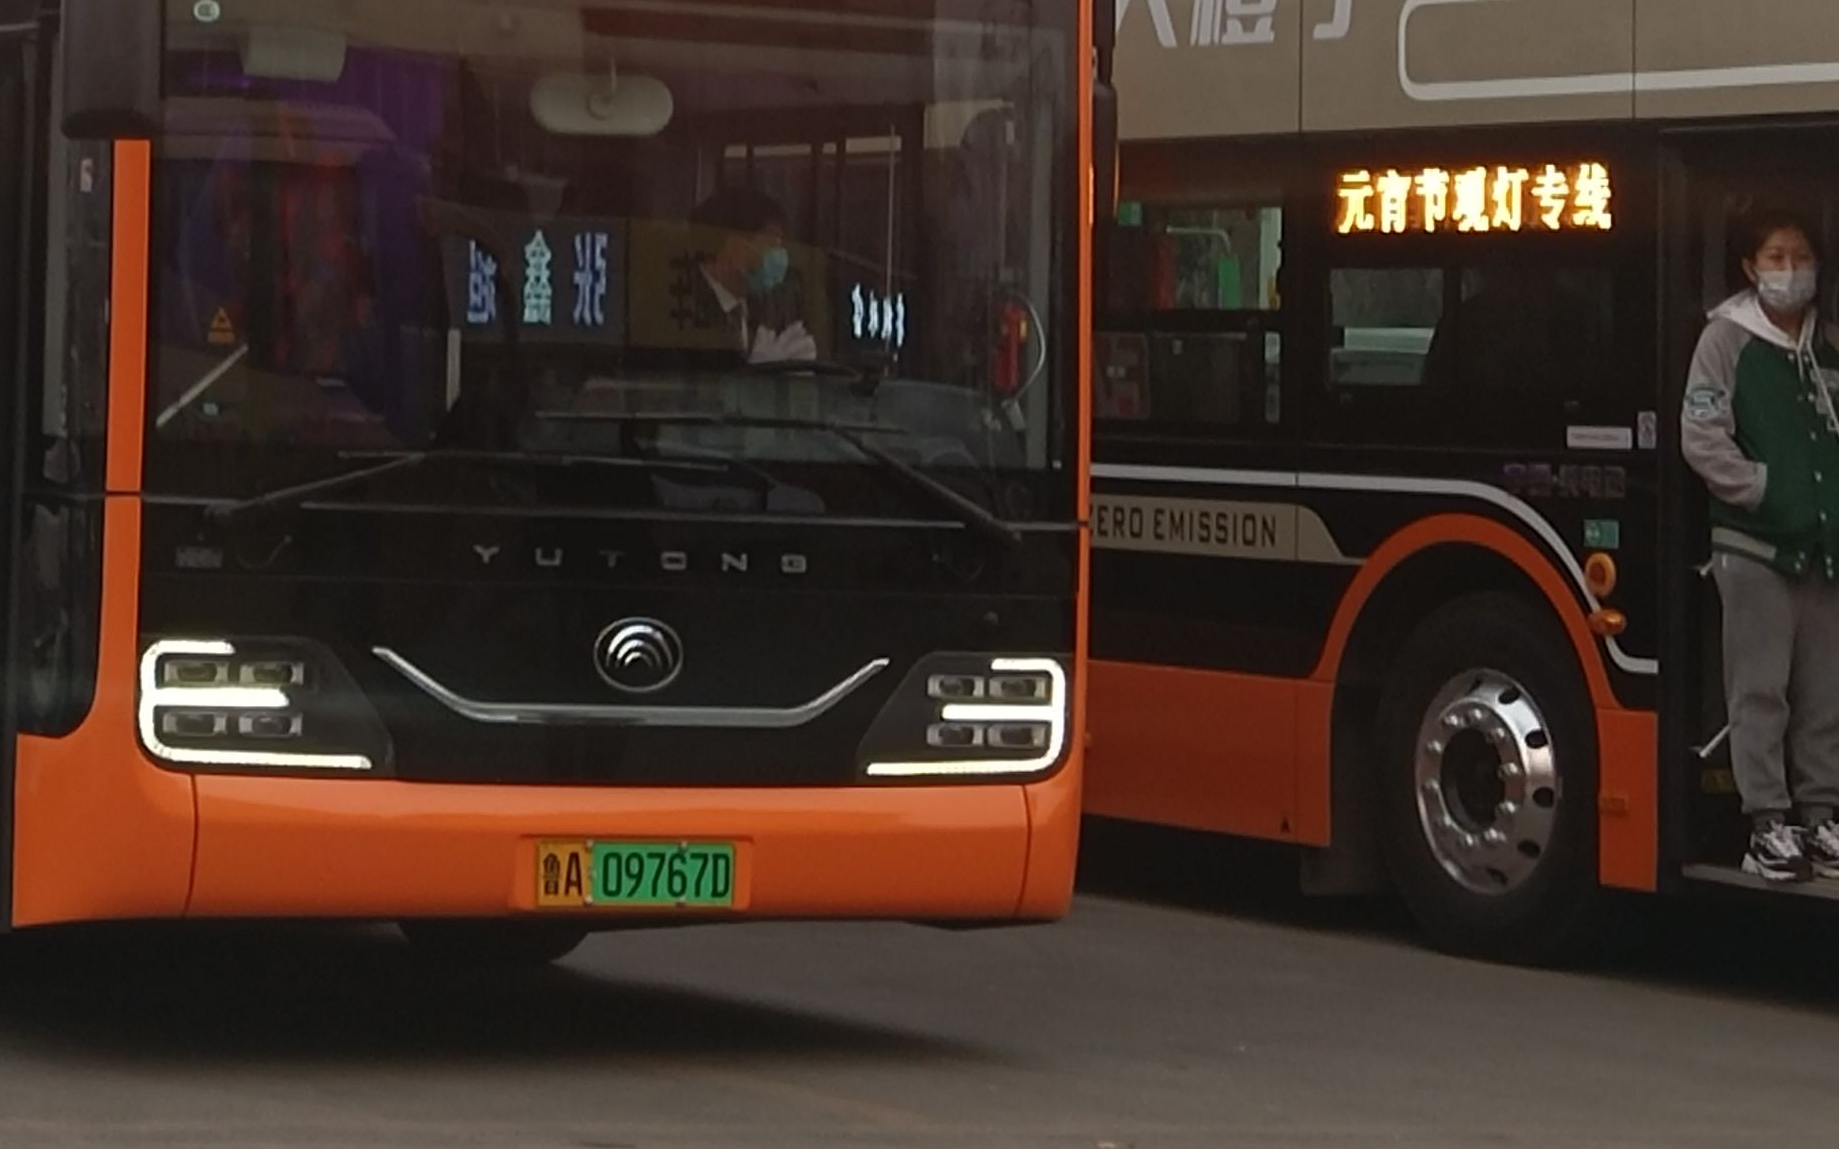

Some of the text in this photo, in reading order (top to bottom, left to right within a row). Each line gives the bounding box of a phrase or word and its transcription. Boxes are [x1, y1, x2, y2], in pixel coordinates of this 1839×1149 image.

[1338, 163, 1612, 233] 元宵节观灯专线
[1091, 505, 1276, 547] ERO EMISSION
[473, 544, 807, 574] YUTONG
